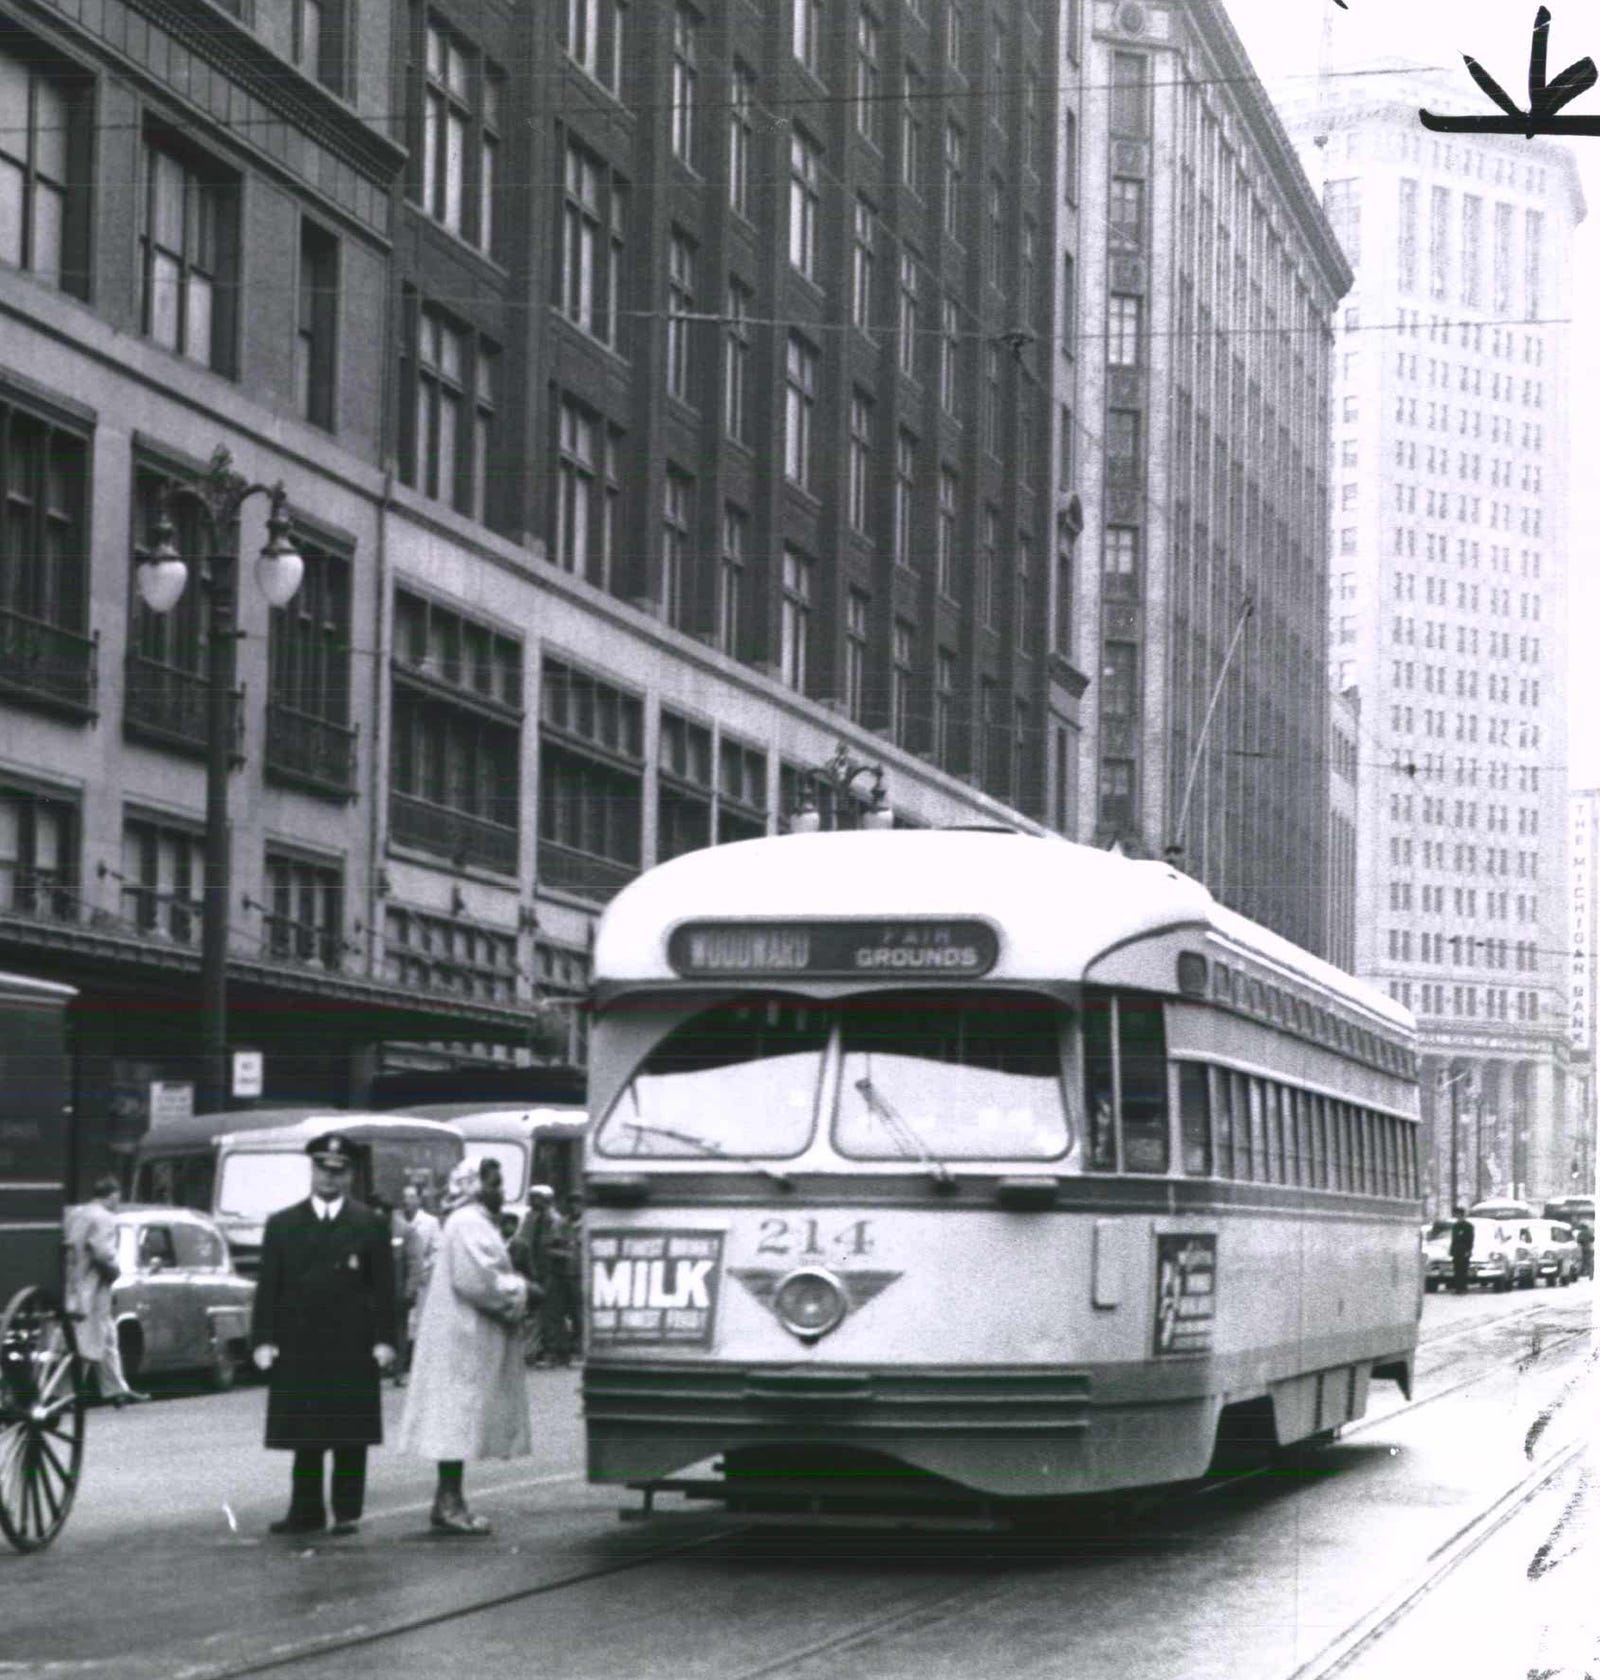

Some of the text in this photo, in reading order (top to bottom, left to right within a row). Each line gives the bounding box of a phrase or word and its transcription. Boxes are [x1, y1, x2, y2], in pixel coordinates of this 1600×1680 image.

[1572, 804, 1585, 1042] THE MICHIGAN BANK
[690, 930, 809, 969] WOODWARD
[854, 946, 979, 968] GROUNDS
[757, 1219, 875, 1254] 214
[592, 1259, 715, 1308] MILK
